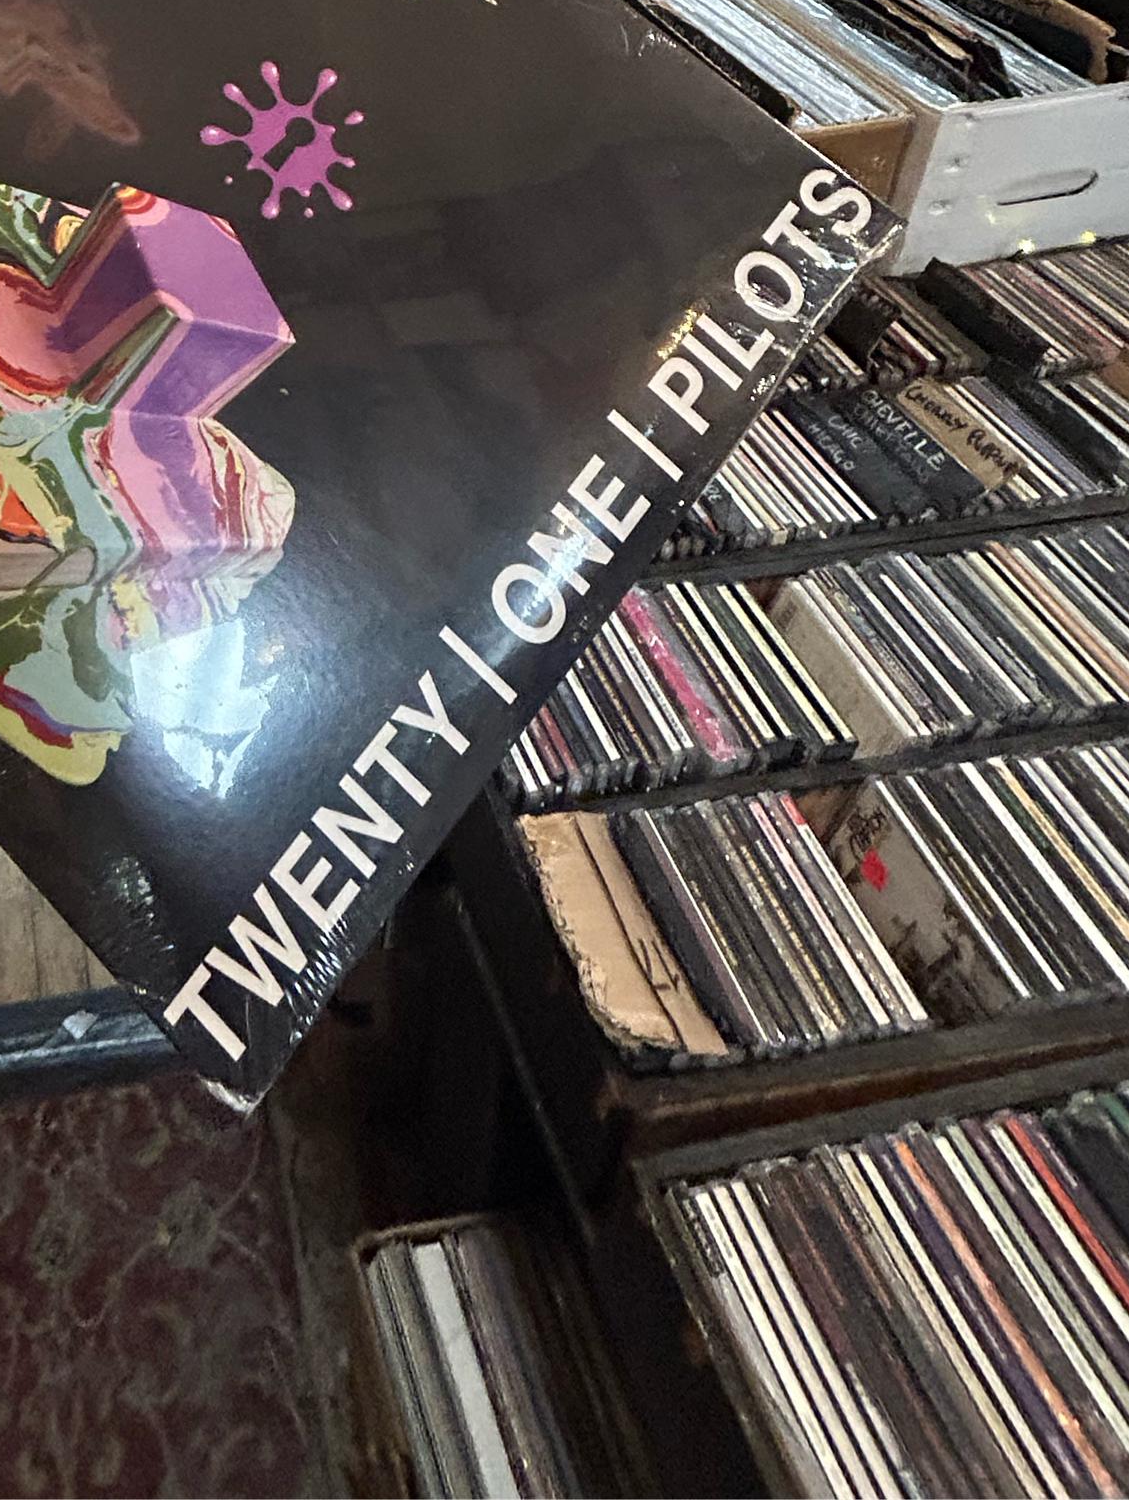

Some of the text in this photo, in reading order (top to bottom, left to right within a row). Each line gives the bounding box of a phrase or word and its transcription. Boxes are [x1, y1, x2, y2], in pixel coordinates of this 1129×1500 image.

[163, 670, 472, 1063] TWENTY
[489, 453, 650, 647] ONE
[647, 167, 874, 436] PILOTS
